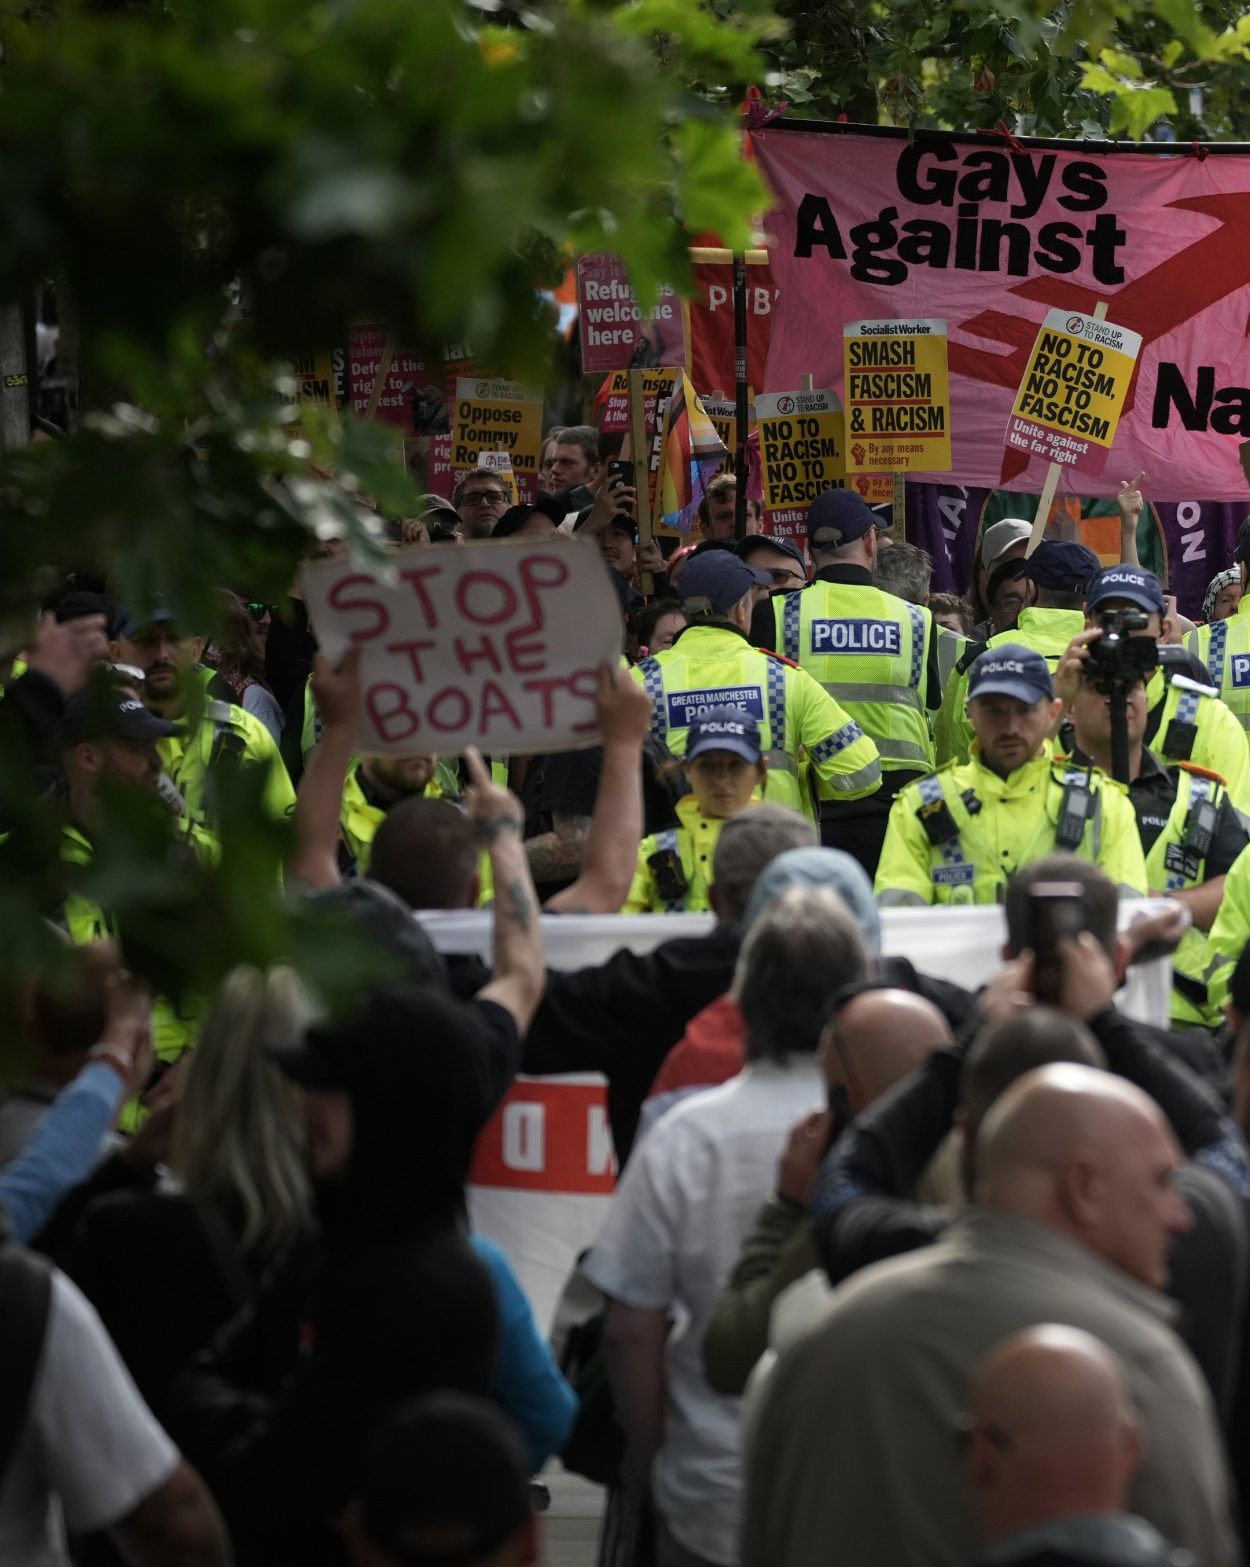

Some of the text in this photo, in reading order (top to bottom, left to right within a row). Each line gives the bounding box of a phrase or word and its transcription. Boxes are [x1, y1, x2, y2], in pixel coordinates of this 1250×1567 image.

[896, 141, 1108, 218] Gays
[794, 192, 1127, 286] Against
[585, 279, 676, 302] Refues
[588, 325, 633, 346] here
[1084, 330, 1124, 350] TO RACISM
[1086, 321, 1122, 339] STAND UP
[849, 340, 915, 366] SMASH
[1040, 333, 1104, 369] NO TO
[402, 359, 425, 372] the
[1033, 353, 1115, 400] RACISM,
[389, 378, 403, 390] to
[850, 373, 931, 399] FASCISM
[1025, 372, 1091, 410] NO TO
[608, 396, 627, 409] Stop
[796, 394, 824, 404] STAND UP
[797, 402, 828, 412] TO RACISM
[458, 401, 522, 425] Oppose
[605, 410, 627, 422] & the
[850, 406, 944, 432] & RACISM
[1018, 393, 1110, 440] FASCISM
[457, 423, 519, 449] Tommy
[763, 418, 819, 442] NO TO
[1013, 419, 1089, 454] Unite against
[765, 437, 840, 463] RACISM,
[869, 443, 924, 454] By any means
[1010, 432, 1078, 464] the far right
[767, 459, 824, 483] NO TO
[869, 456, 910, 467] necessary
[772, 509, 802, 523] Unite
[774, 525, 793, 537] the
[1102, 572, 1146, 587] POLICE
[328, 554, 571, 641] STOP
[814, 621, 899, 650] POLICE
[385, 632, 547, 685] THE
[980, 661, 1025, 675] POLICE
[364, 669, 602, 744] BOATS
[672, 690, 758, 706] GREATER MANCHESTER
[700, 722, 744, 734] POLICE
